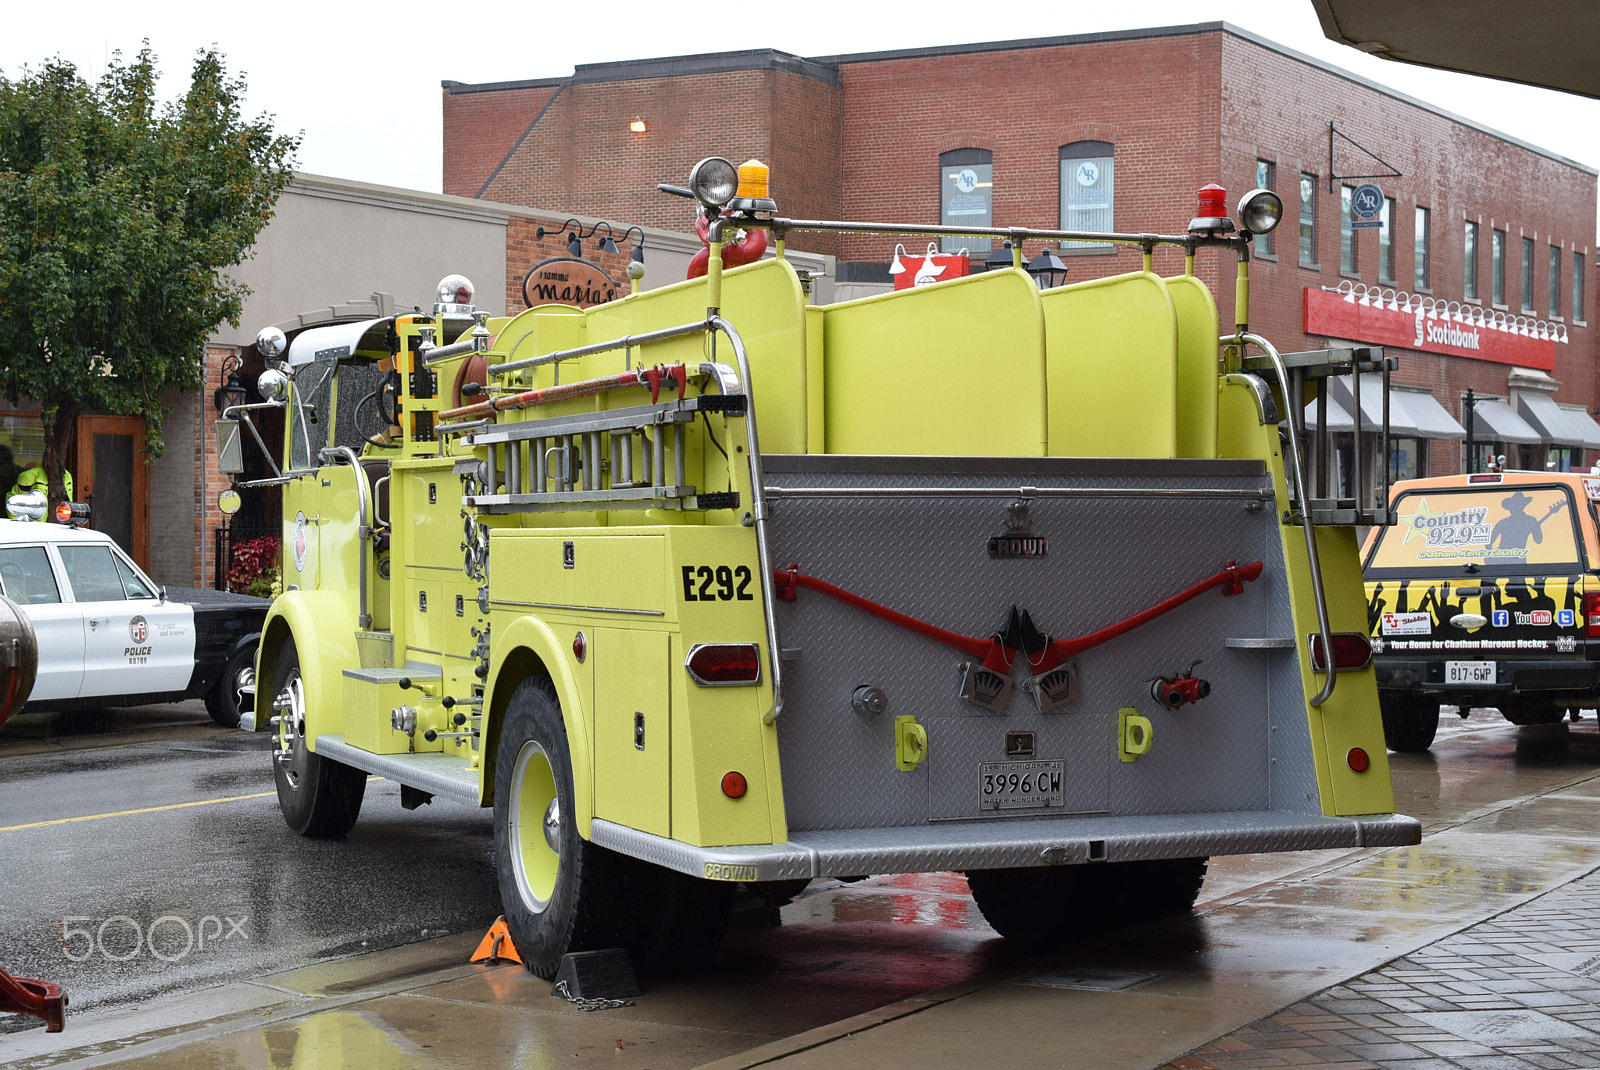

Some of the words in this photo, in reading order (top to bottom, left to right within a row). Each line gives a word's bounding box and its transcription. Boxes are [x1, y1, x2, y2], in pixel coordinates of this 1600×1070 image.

[1426, 319, 1480, 350] Scotiabank
[1414, 511, 1486, 529] Country
[1428, 526, 1473, 544] 92.9
[1473, 526, 1489, 535] FM
[1490, 548, 1527, 558] Country
[681, 565, 754, 602] E292
[124, 646, 152, 656] POLICE
[1391, 640, 1408, 649] Your
[1409, 640, 1431, 649] Home
[1432, 640, 1444, 649] for
[1444, 640, 1480, 649] Chatham
[1480, 640, 1517, 649] Maroons
[1517, 639, 1549, 650] Hockey.
[705, 863, 755, 880] CROWN
